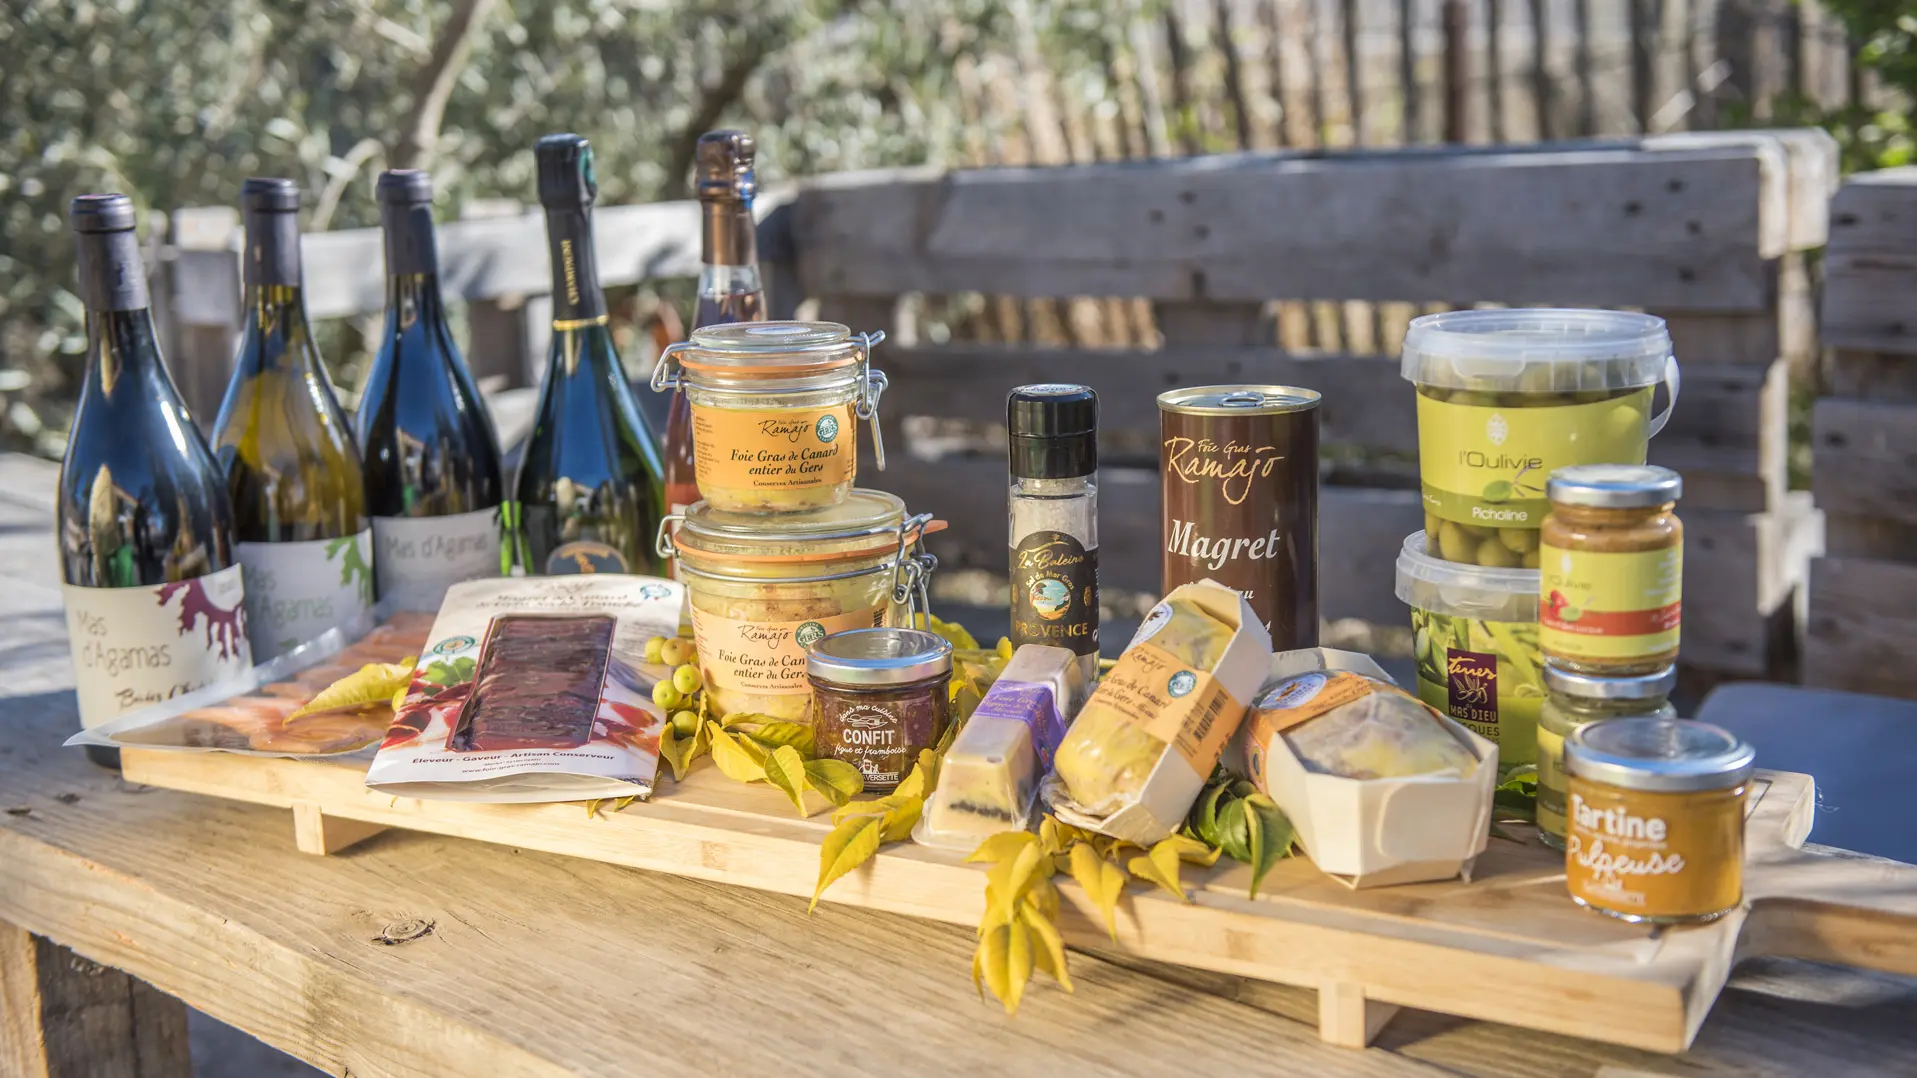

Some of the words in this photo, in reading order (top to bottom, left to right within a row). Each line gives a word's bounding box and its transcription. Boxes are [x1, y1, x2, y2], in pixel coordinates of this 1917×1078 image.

[818, 423, 838, 437] GERS
[731, 448, 754, 461] Foie
[757, 449, 786, 462] Gras
[788, 451, 799, 461] de
[801, 443, 839, 461] Canard
[1197, 439, 1220, 453] Foie
[1223, 439, 1252, 460] Gras
[749, 463, 783, 475] entier
[785, 465, 796, 475] du
[799, 461, 824, 473] Gers
[1459, 450, 1543, 469] l'Oulivie
[1471, 506, 1528, 521] Picholine
[1167, 518, 1281, 571] Magret
[1018, 550, 1034, 569] La
[1034, 549, 1085, 570] Baleine
[797, 630, 824, 643] GERS
[1015, 619, 1088, 638] PROVENCE
[718, 648, 737, 663] Foie
[739, 653, 766, 667] Gras
[768, 656, 779, 667] de
[781, 654, 805, 667] Can
[733, 667, 764, 679] entier
[766, 669, 778, 680] du
[871, 705, 899, 724] cuisine
[1450, 704, 1469, 718] MAS
[1471, 709, 1497, 722] DIEU
[842, 728, 895, 746] CONFIT
[1467, 723, 1500, 737] QUES
[510, 751, 550, 759] Artisan
[552, 751, 615, 760] Conserveur
[833, 742, 854, 756] figue
[854, 746, 864, 754] et
[862, 745, 907, 760] framboise
[1571, 793, 1667, 842] Tartine
[1567, 834, 1686, 881] Pulpeuse
